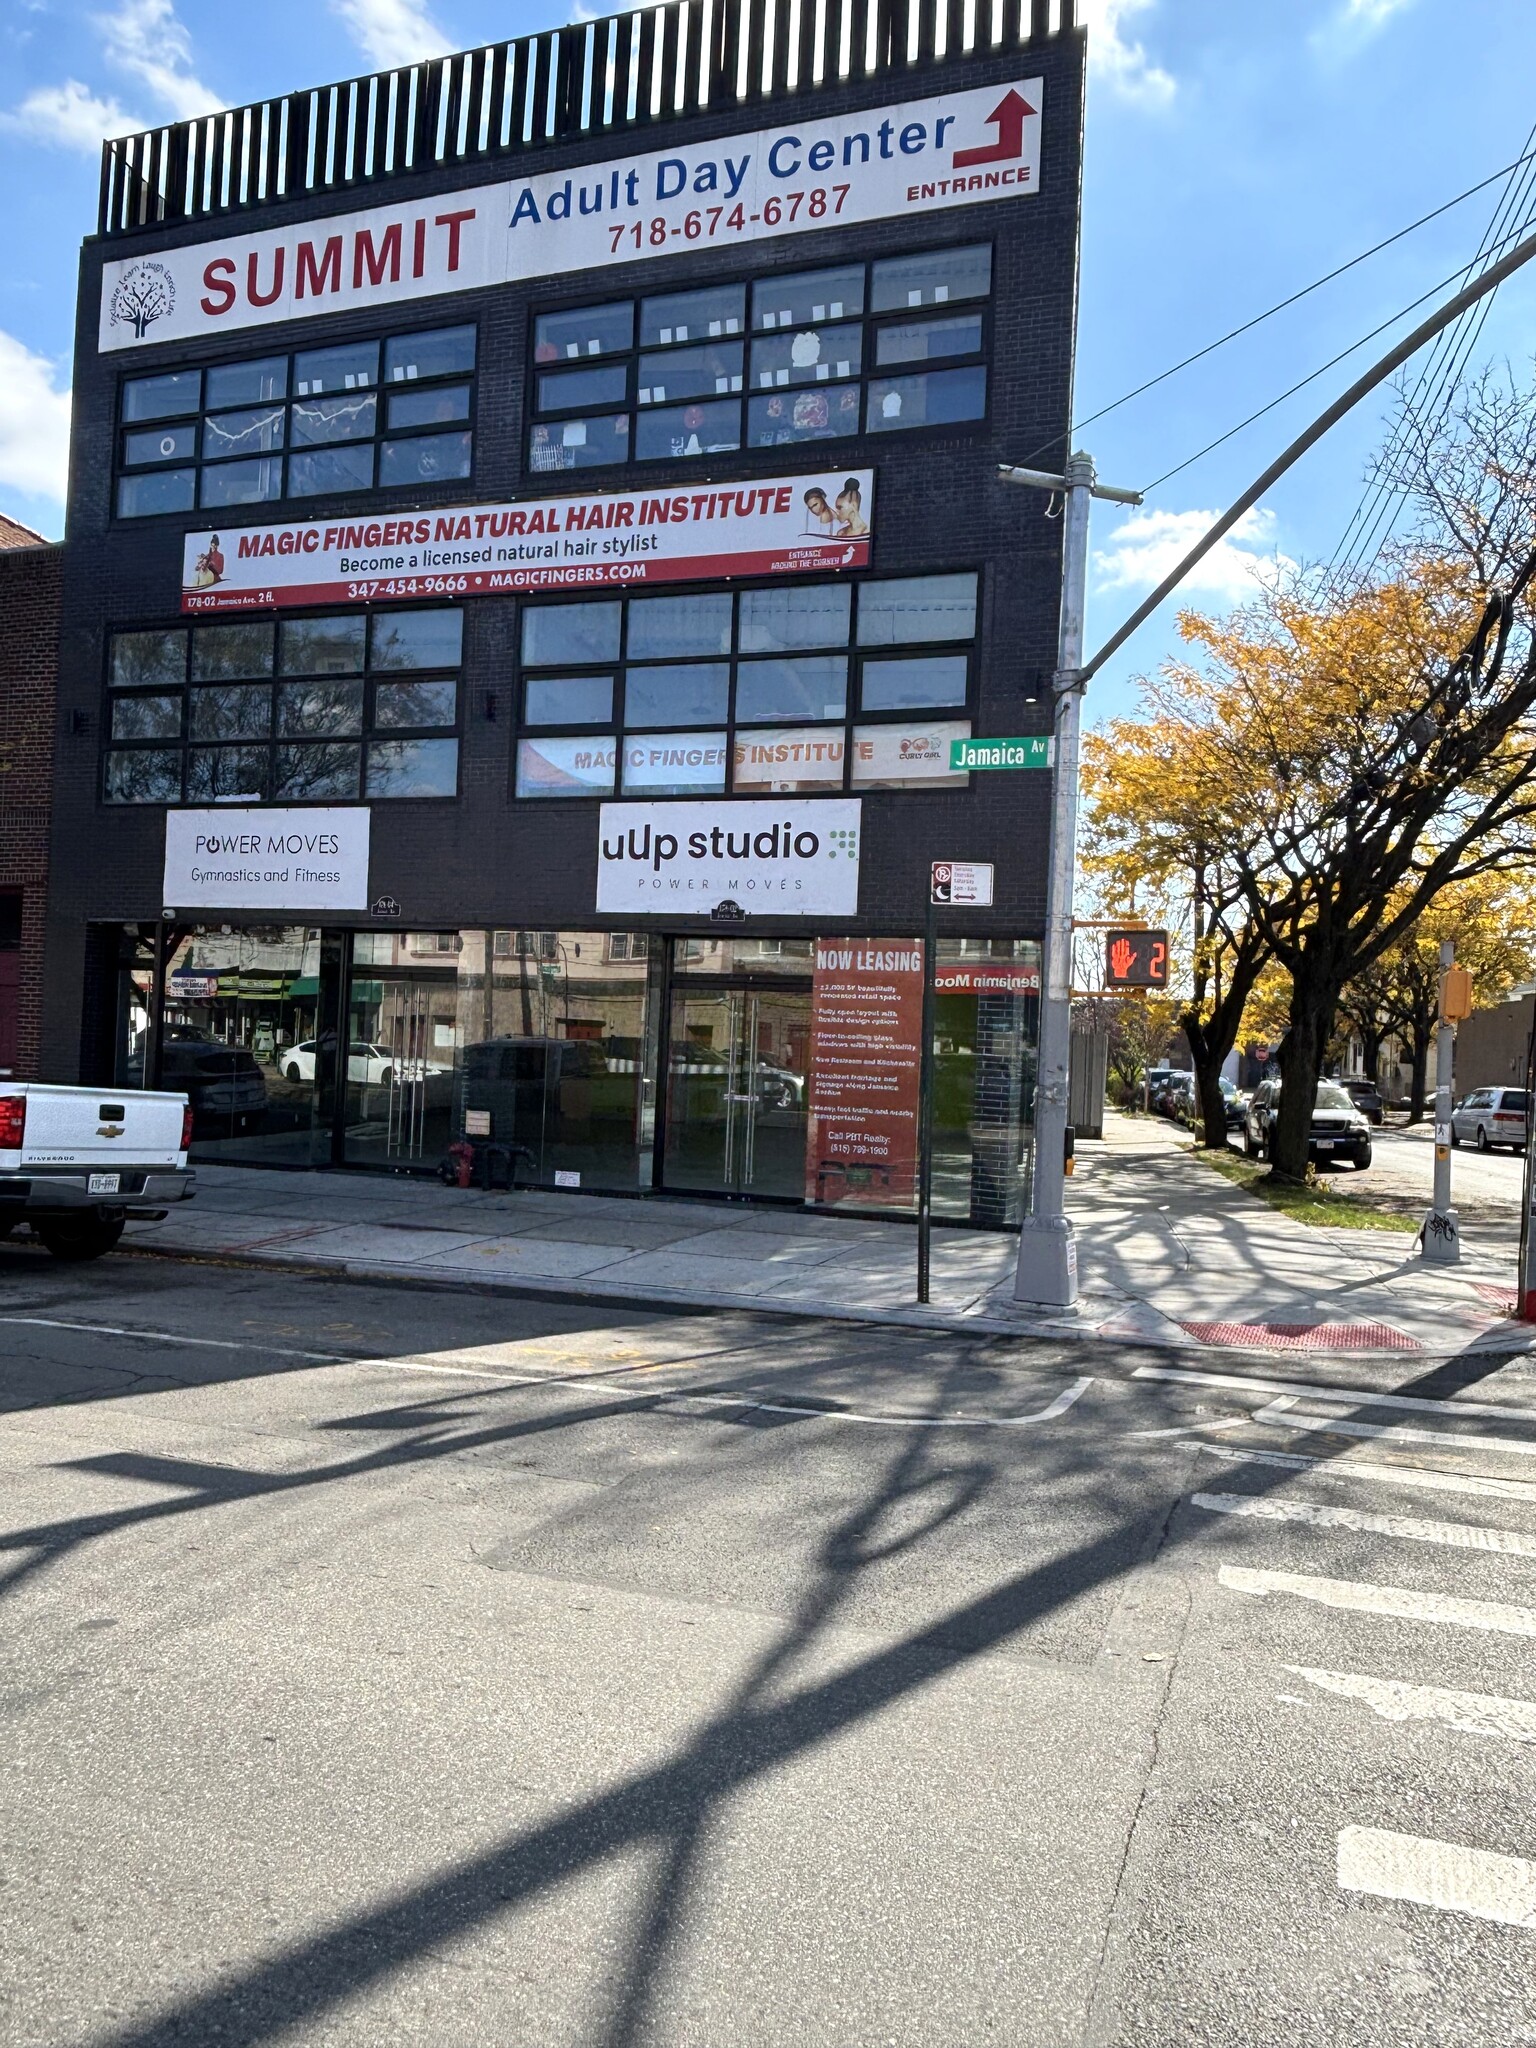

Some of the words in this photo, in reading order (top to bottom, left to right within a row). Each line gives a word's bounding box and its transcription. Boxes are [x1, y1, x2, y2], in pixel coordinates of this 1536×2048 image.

[509, 170, 641, 228] Adult
[656, 153, 752, 201] Day
[768, 115, 956, 178] Center
[907, 166, 1031, 202] ENTRANCE
[609, 183, 851, 253] 718-674-6787
[200, 208, 476, 316] SUMMIT
[238, 529, 319, 559] MAGIC
[322, 517, 430, 551] FINGERS
[434, 509, 560, 542] NATURAL
[565, 502, 635, 532] HAIR
[638, 486, 793, 526] INSTITUTE
[340, 556, 404, 573] Become
[409, 556, 418, 568] a
[423, 545, 491, 567] licensed
[497, 540, 558, 561] natural
[564, 538, 597, 556] hair
[602, 533, 658, 557] stylist
[348, 575, 468, 598] 347-454-9666
[489, 564, 646, 588] MAGICFINGERS.COM
[188, 596, 216, 607] 178-02
[258, 592, 265, 603] 2
[955, 742, 1024, 766] Jamaica
[1031, 740, 1045, 753] Av
[196, 835, 261, 854] POWER
[267, 834, 339, 854] MOVES
[688, 821, 820, 859] studio
[191, 867, 261, 885] Gymnastics
[264, 868, 289, 882] and
[295, 868, 341, 883] Fitness
[638, 878, 709, 889] POWER
[728, 878, 802, 890] MOVES
[817, 950, 853, 970] NOW
[857, 950, 921, 972] LEASING
[1149, 942, 1165, 978] 2
[828, 1131, 844, 1140] Call
